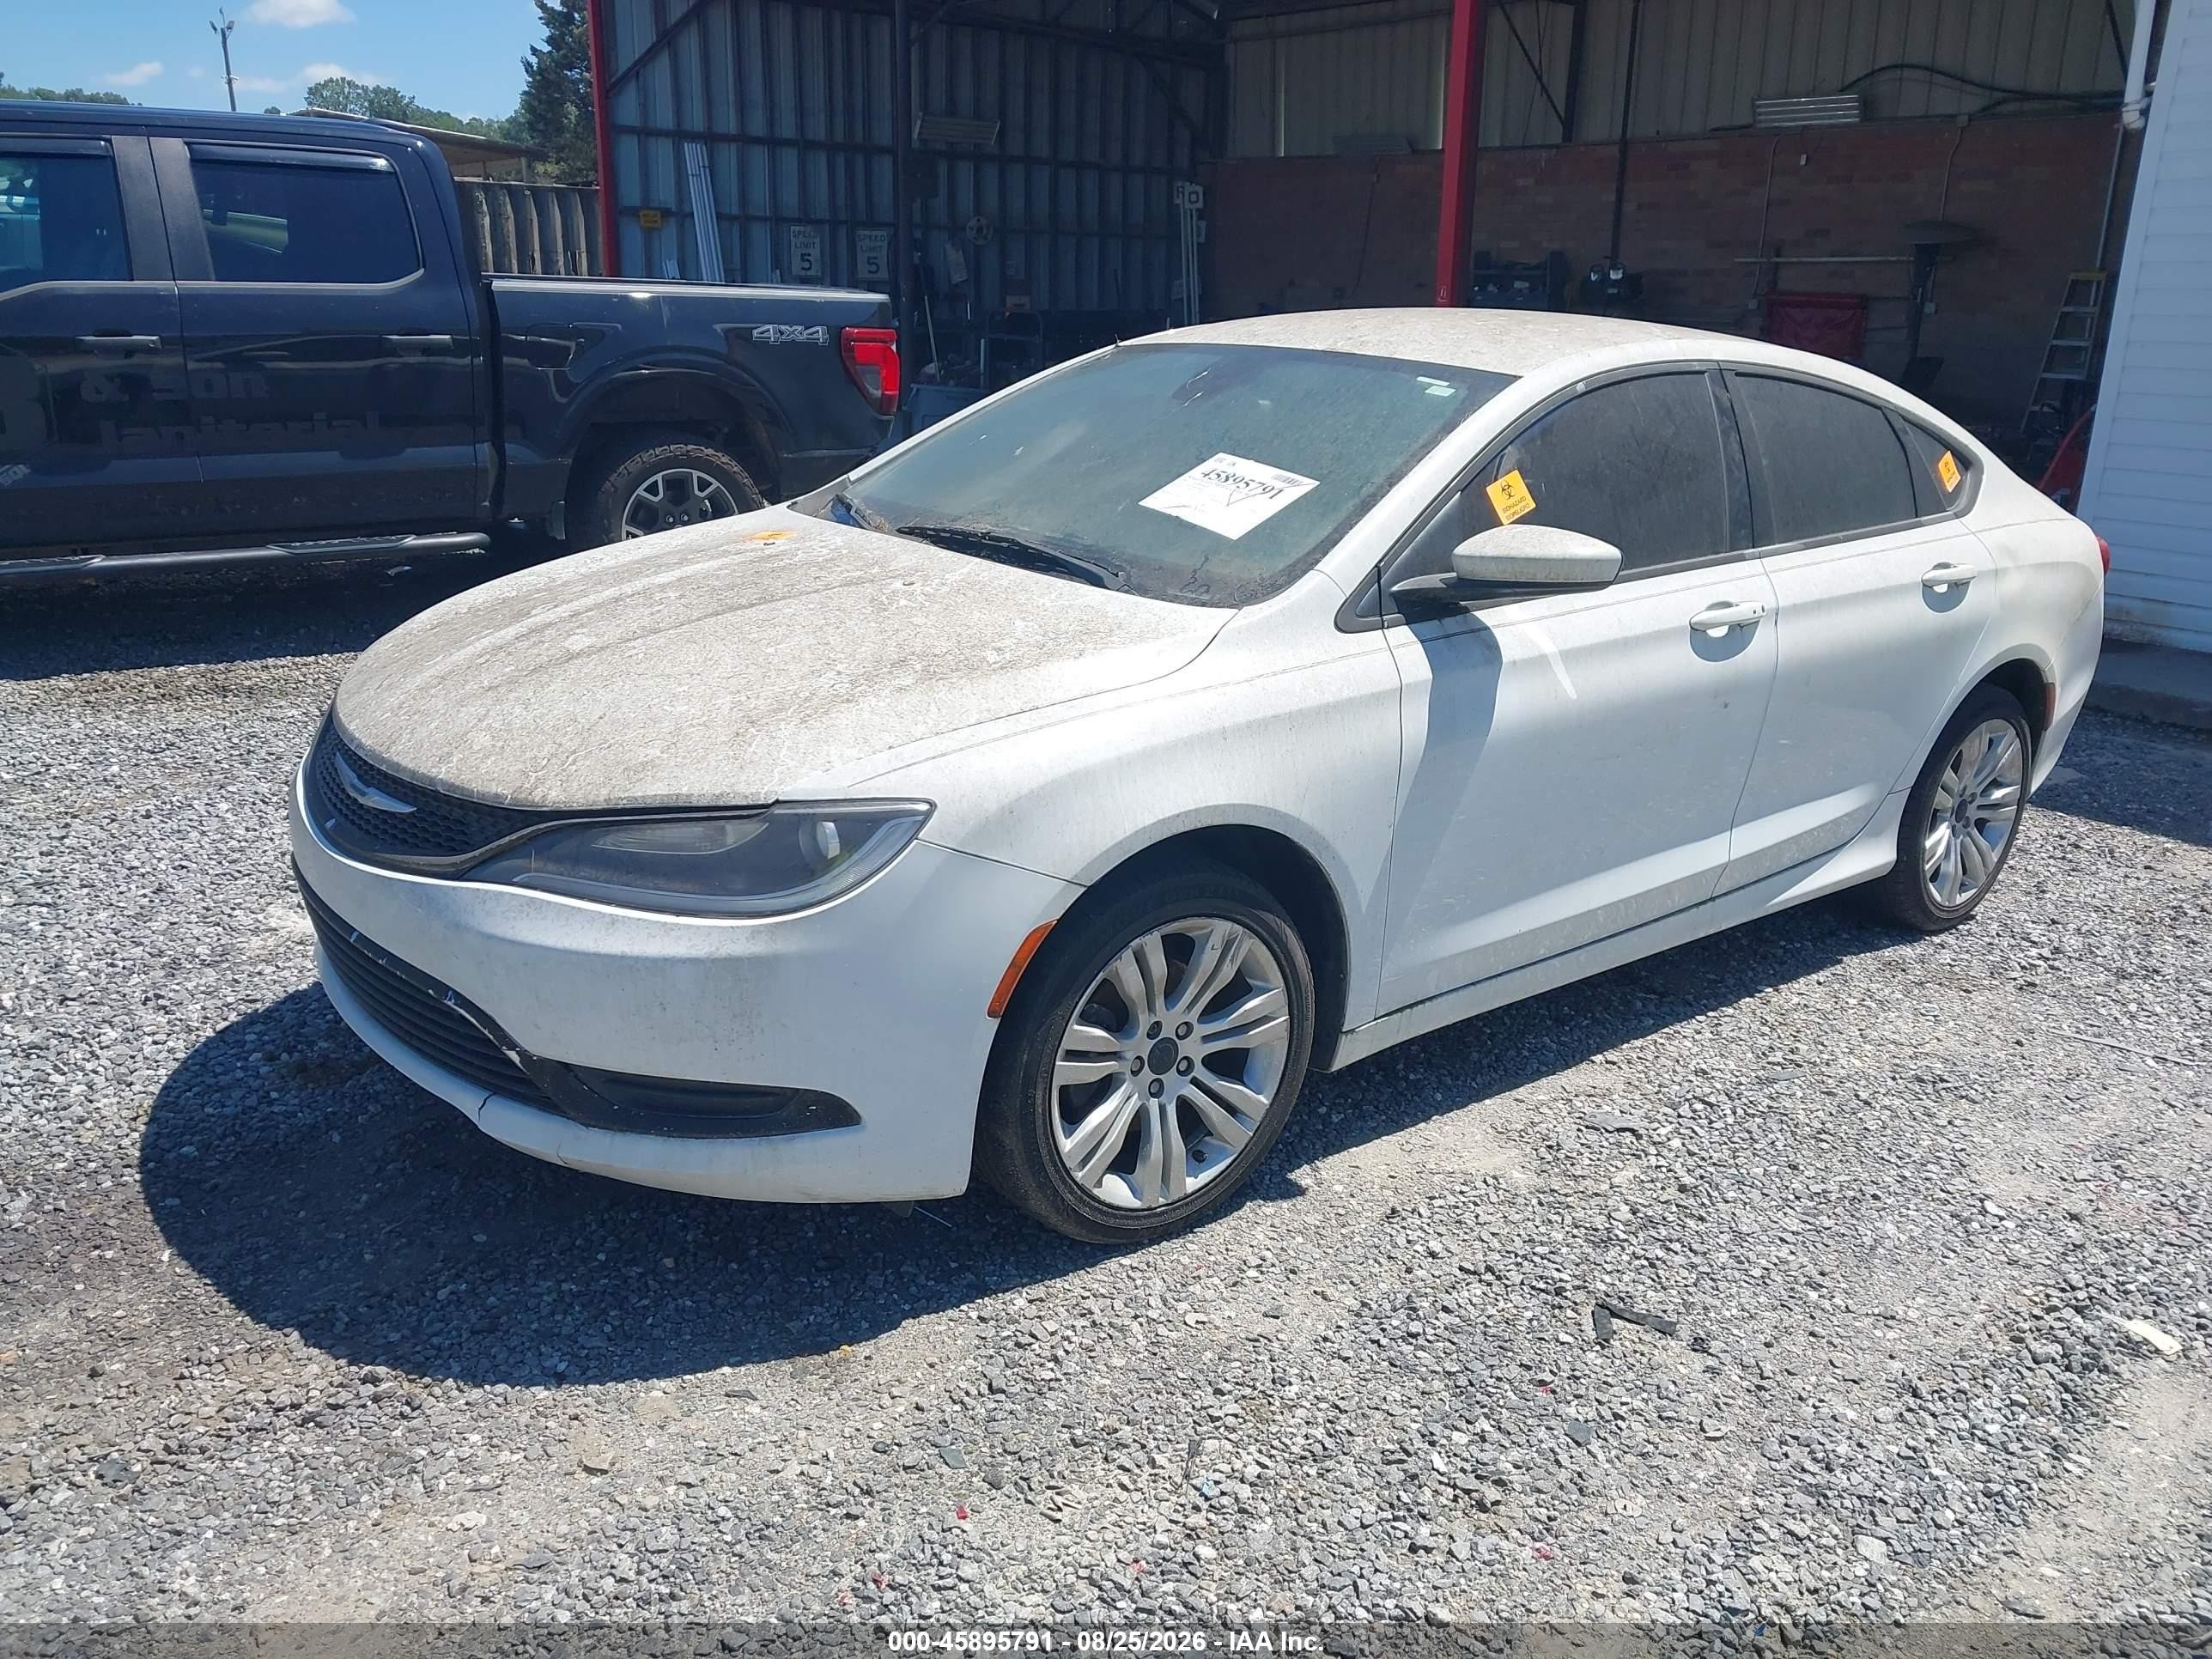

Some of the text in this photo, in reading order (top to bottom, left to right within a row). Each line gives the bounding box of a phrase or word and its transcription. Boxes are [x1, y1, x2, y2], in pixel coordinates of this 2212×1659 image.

[793, 229, 818, 239] SPE
[858, 234, 886, 242] SPEED
[794, 240, 816, 250] LIMIT
[860, 245, 884, 254] LIMIT
[799, 252, 812, 272] 5
[866, 256, 880, 275] 5
[1200, 468, 1285, 500] 45895791
[1502, 495, 1527, 514] BIOHAZARD
